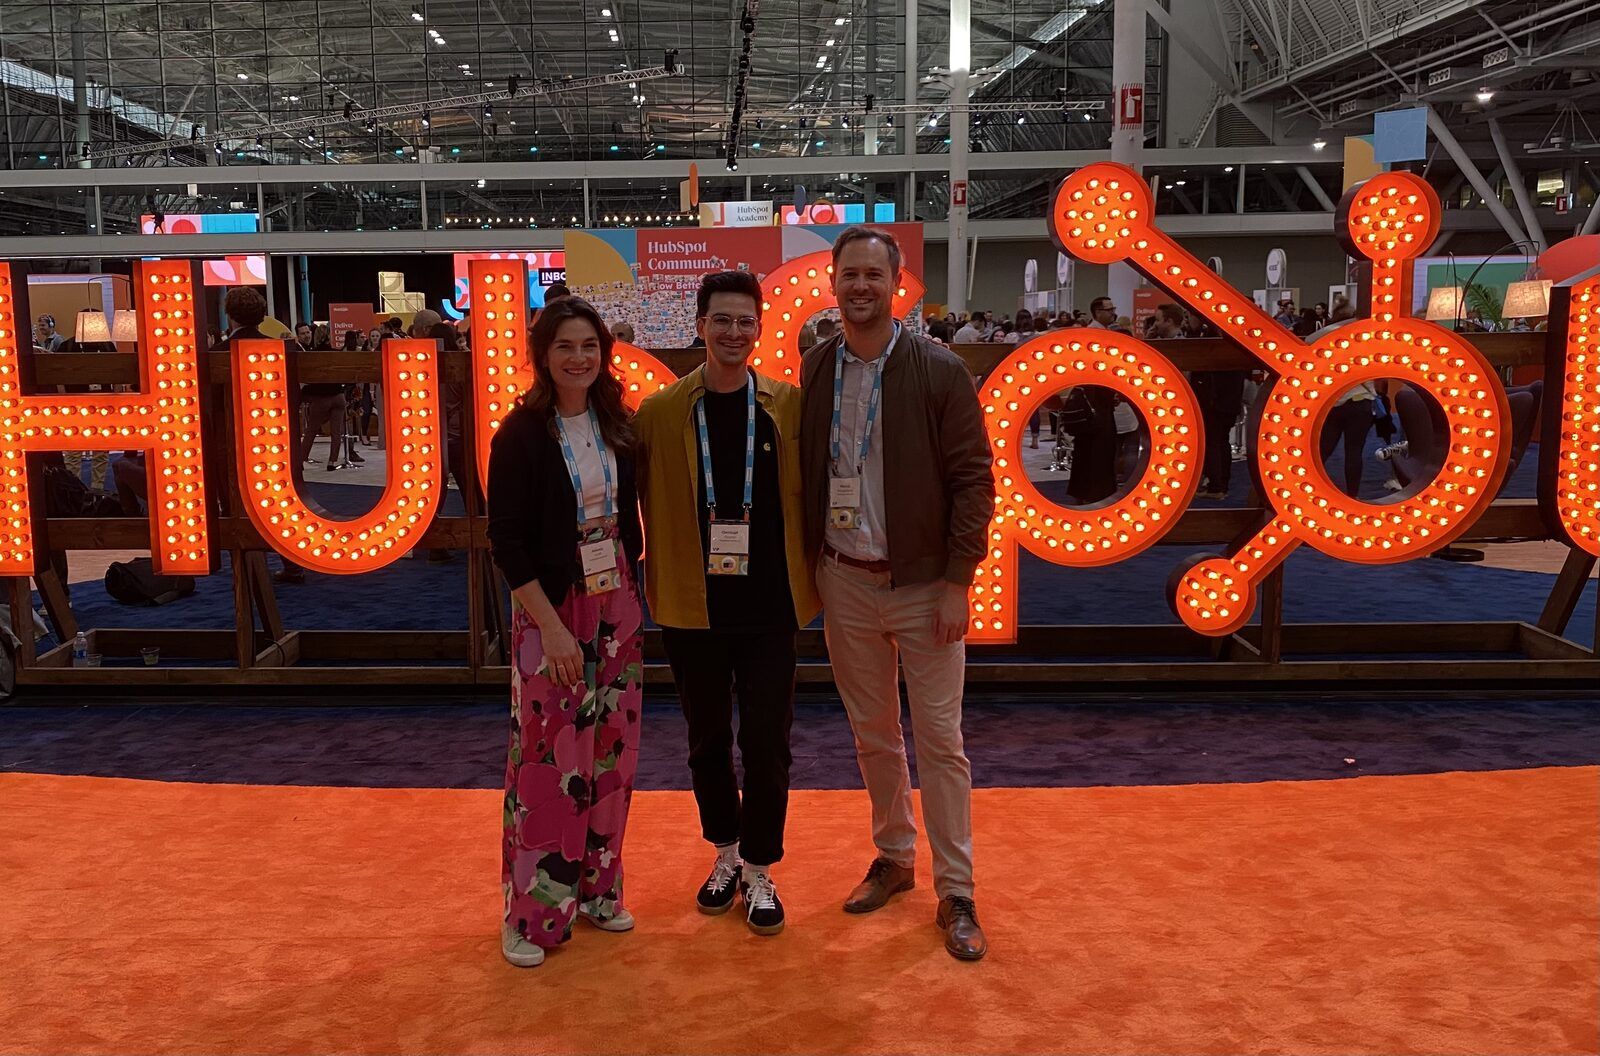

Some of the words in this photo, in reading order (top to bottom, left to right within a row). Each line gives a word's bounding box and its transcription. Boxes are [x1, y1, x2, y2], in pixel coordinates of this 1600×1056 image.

[648, 241, 707, 255] HubSpot
[648, 258, 728, 270] Communy
[676, 282, 700, 290] Bette
[0, 161, 1600, 646] Hubpo
